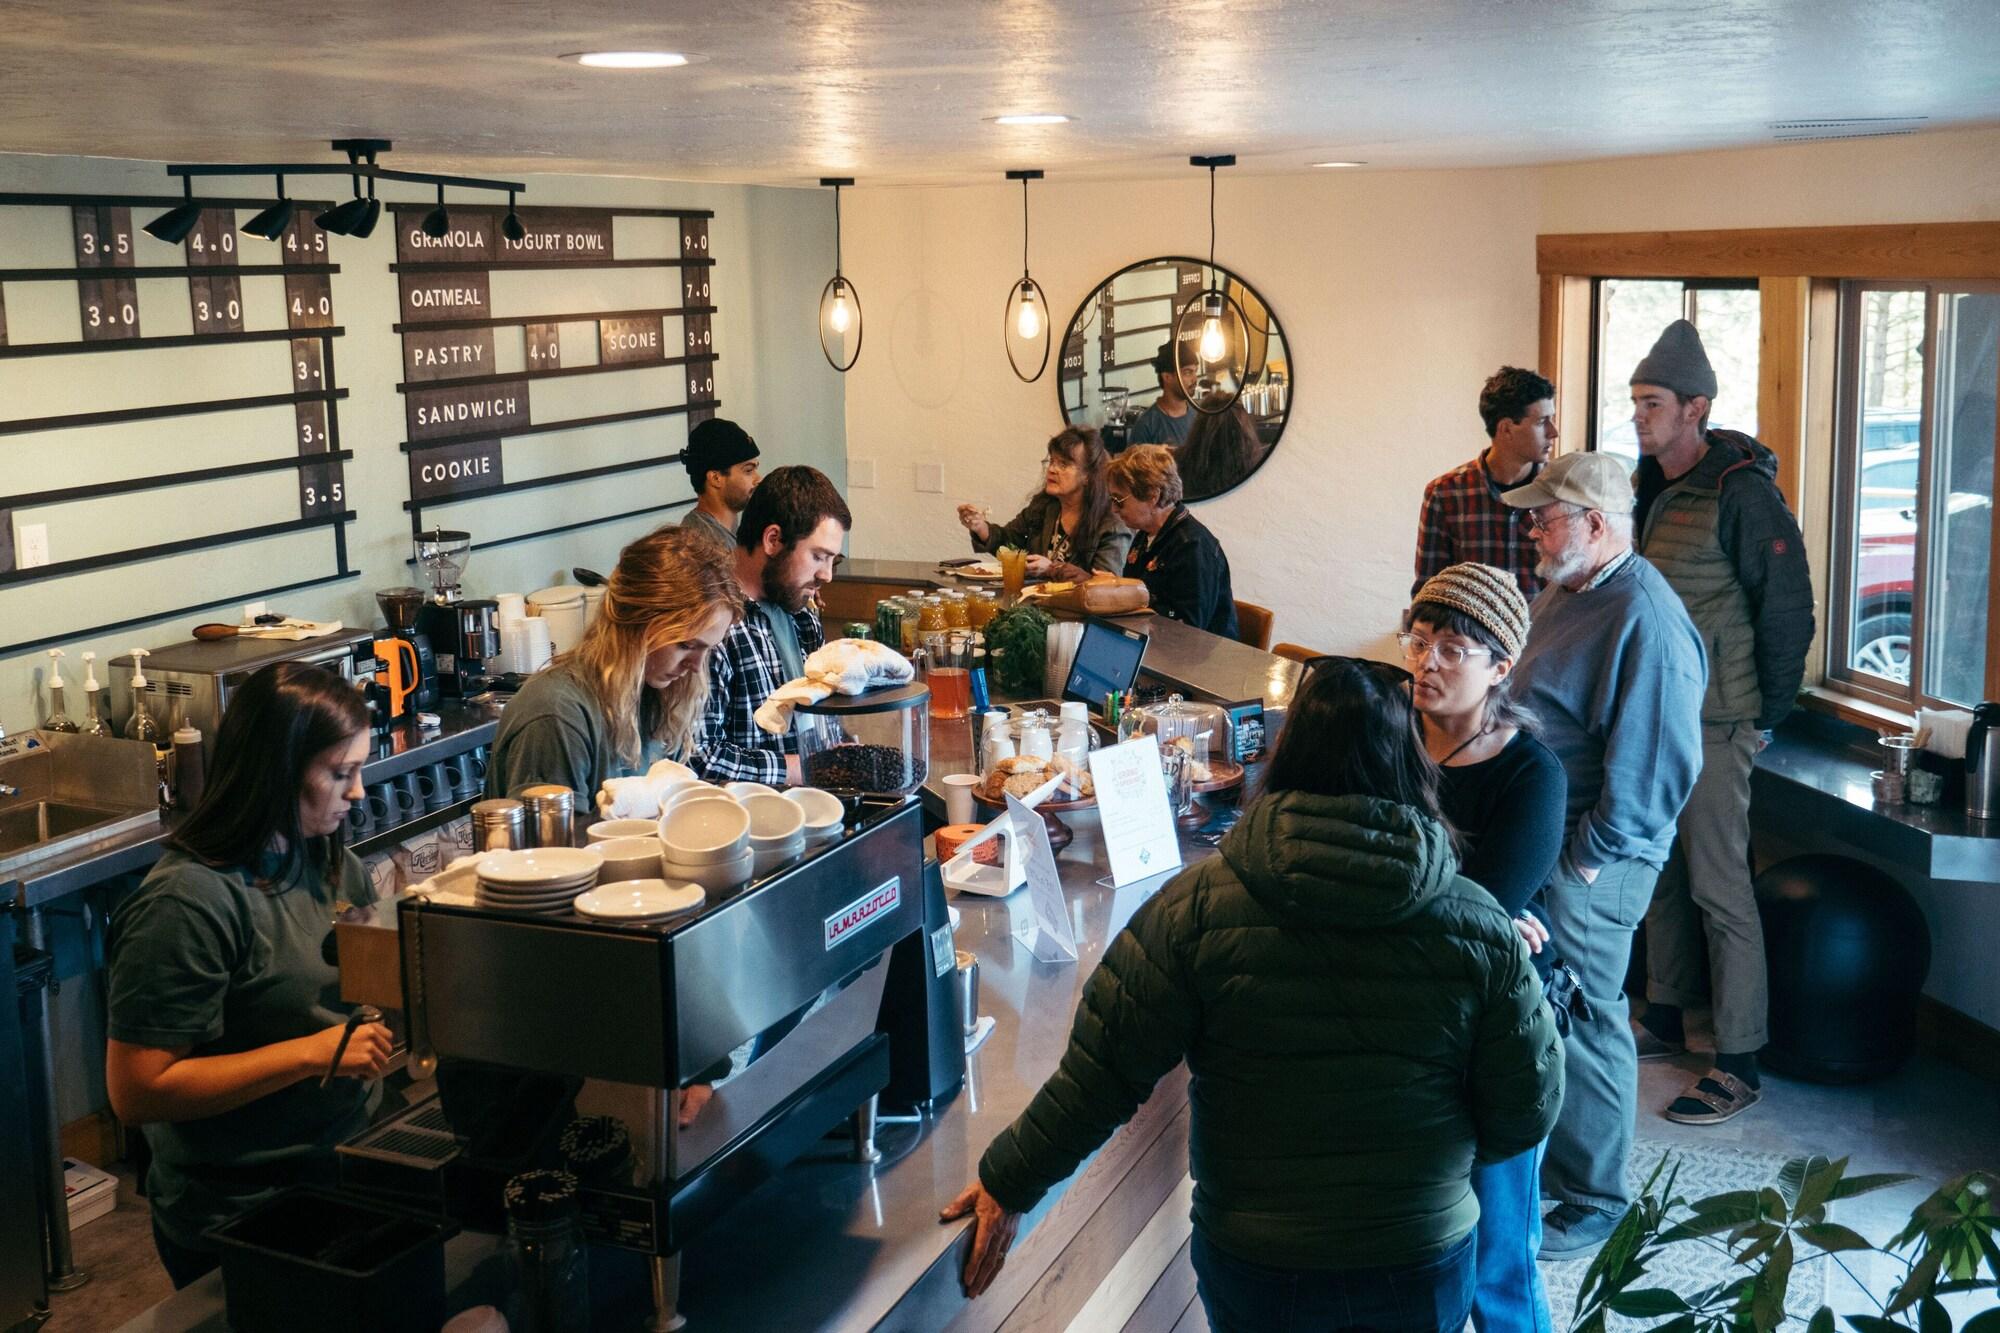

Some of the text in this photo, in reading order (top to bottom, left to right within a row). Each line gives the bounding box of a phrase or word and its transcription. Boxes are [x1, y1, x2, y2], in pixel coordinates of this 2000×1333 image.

[83, 233, 129, 254] 3.5
[193, 232, 234, 252] 4.0
[287, 232, 325, 252] 4.5
[411, 230, 604, 250] GRANOLA YOGURT BOWL
[684, 235, 708, 250] 9.0
[411, 288, 481, 307] OATMEAL
[686, 283, 709, 299] 7.0
[89, 304, 135, 327] 3.0
[198, 300, 240, 322] 3.0
[292, 296, 330, 316] 4.0
[609, 332, 657, 351] SCONE
[689, 331, 711, 347] 3.0
[414, 345, 483, 366] PASTRY
[530, 343, 558, 360] 4.0
[691, 380, 713, 395] 8.0
[418, 398, 517, 425] SANDWICH
[421, 456, 491, 483] COOKIE
[306, 483, 343, 506] 3.5
